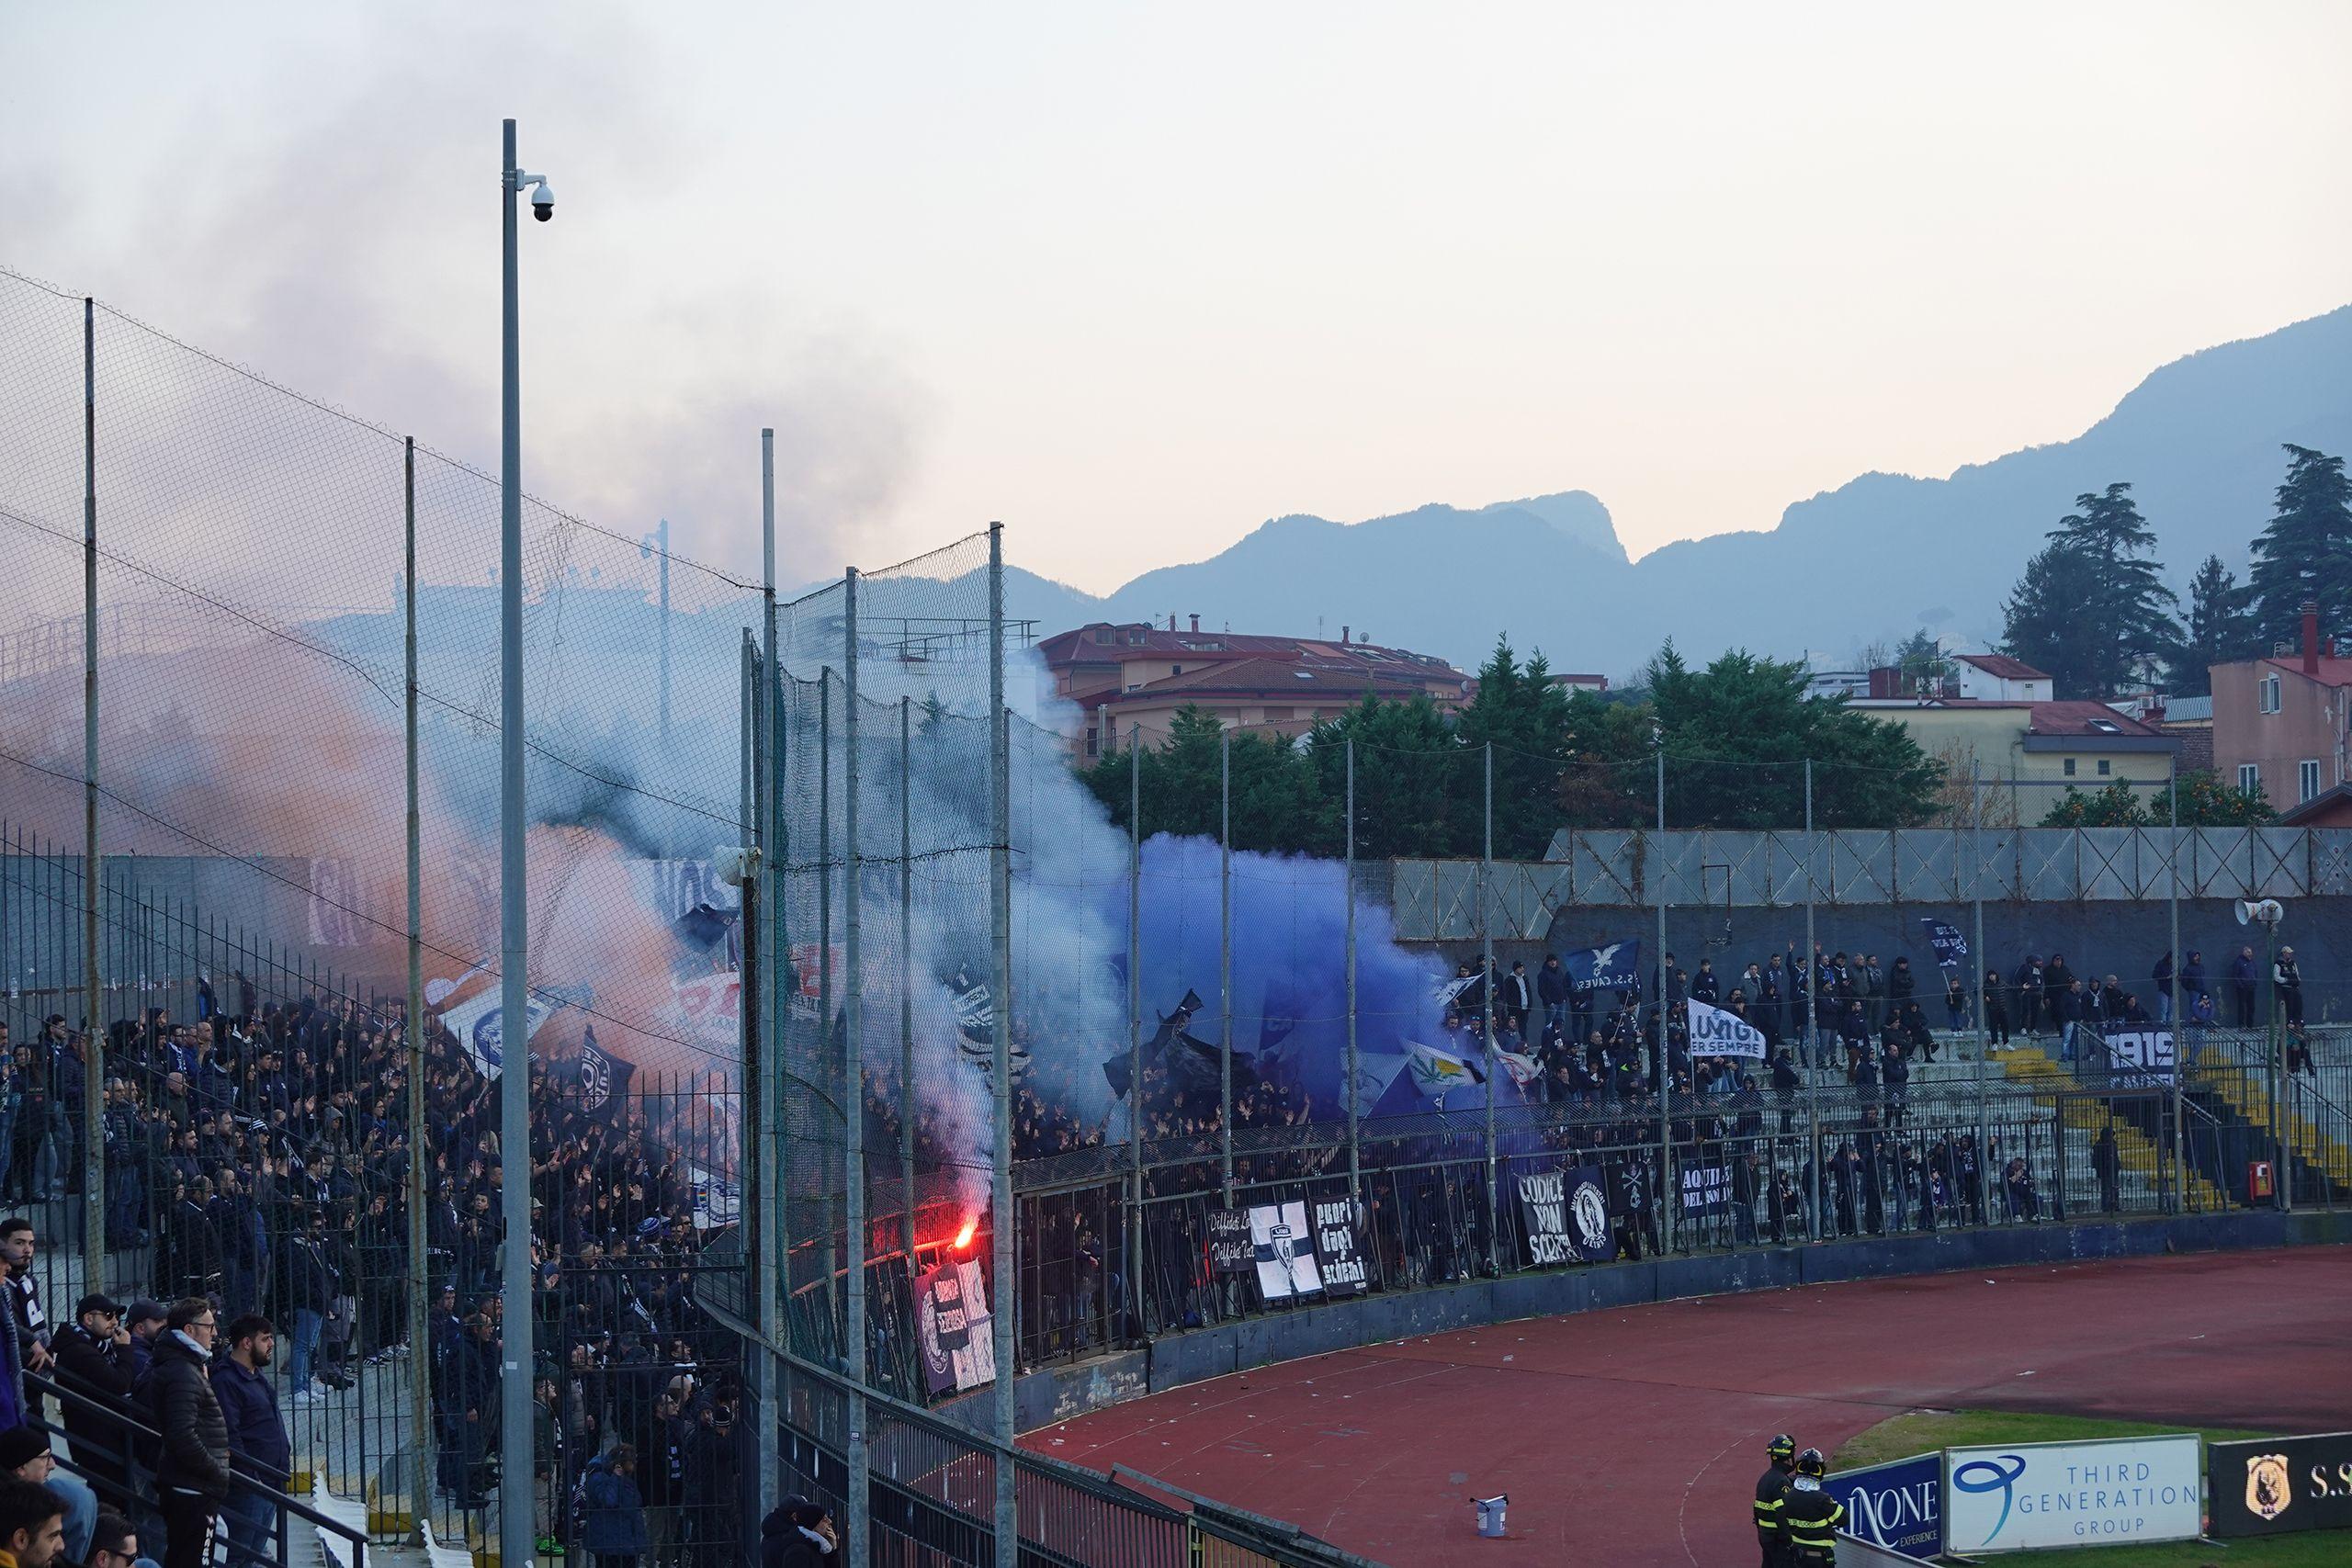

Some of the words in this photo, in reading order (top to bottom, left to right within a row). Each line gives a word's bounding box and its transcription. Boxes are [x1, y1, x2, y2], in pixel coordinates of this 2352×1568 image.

[1709, 1041, 1759, 1055] SEMPRE
[1519, 1175, 1564, 1203] CODICE
[1532, 1203, 1562, 1233] NON
[2066, 1462, 2150, 1484] THIRD
[2018, 1484, 2197, 1514] GENERATION
[2074, 1517, 2144, 1536] GROUP
[1899, 1529, 1939, 1548] EXPERIENCE
